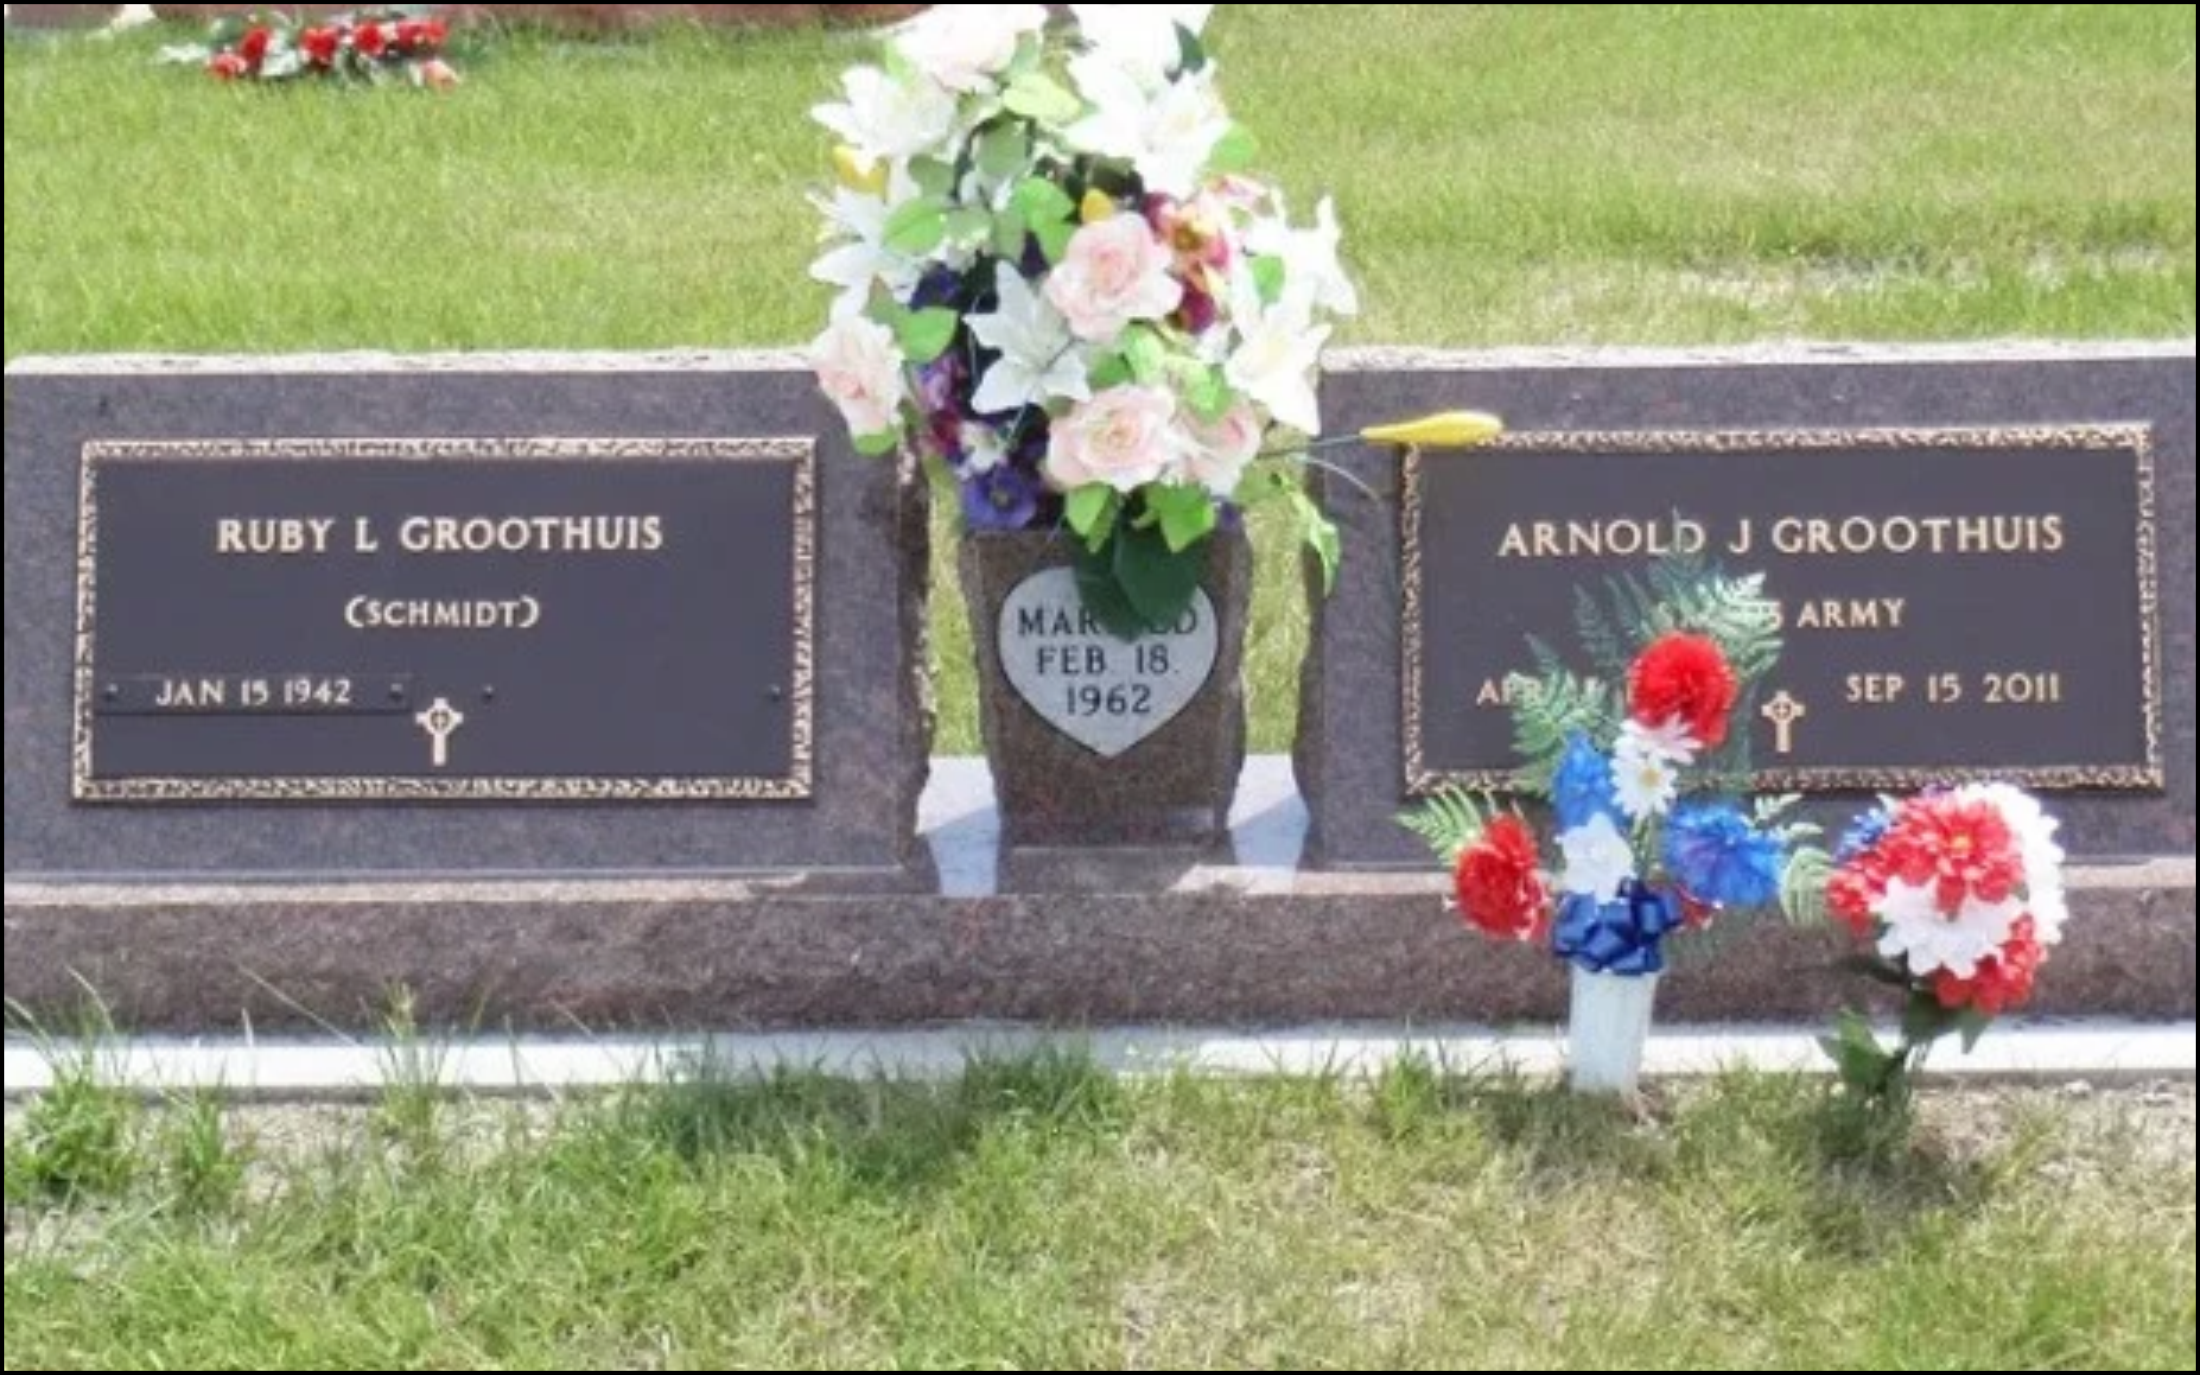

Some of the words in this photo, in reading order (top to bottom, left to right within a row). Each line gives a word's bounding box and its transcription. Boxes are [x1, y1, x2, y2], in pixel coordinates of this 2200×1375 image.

[217, 517, 336, 553] RUBY
[355, 517, 379, 552] L
[398, 514, 664, 552] GROOTHUIS
[1497, 517, 1707, 557] ARNOLD
[1727, 518, 1752, 554] J
[1771, 513, 2065, 554] GROOTHUIS
[344, 595, 540, 629] (SCHMIDT)
[1017, 604, 1198, 637] MARD
[1796, 597, 1906, 629] ARMY
[1036, 645, 1107, 676] FEB
[156, 679, 225, 706] JAN
[240, 679, 270, 706] 15
[283, 678, 352, 706] 1942
[1066, 682, 1152, 716] 1962
[1845, 672, 1906, 703] SEP
[1927, 672, 1963, 704] 15
[1982, 671, 2061, 703] 2011
